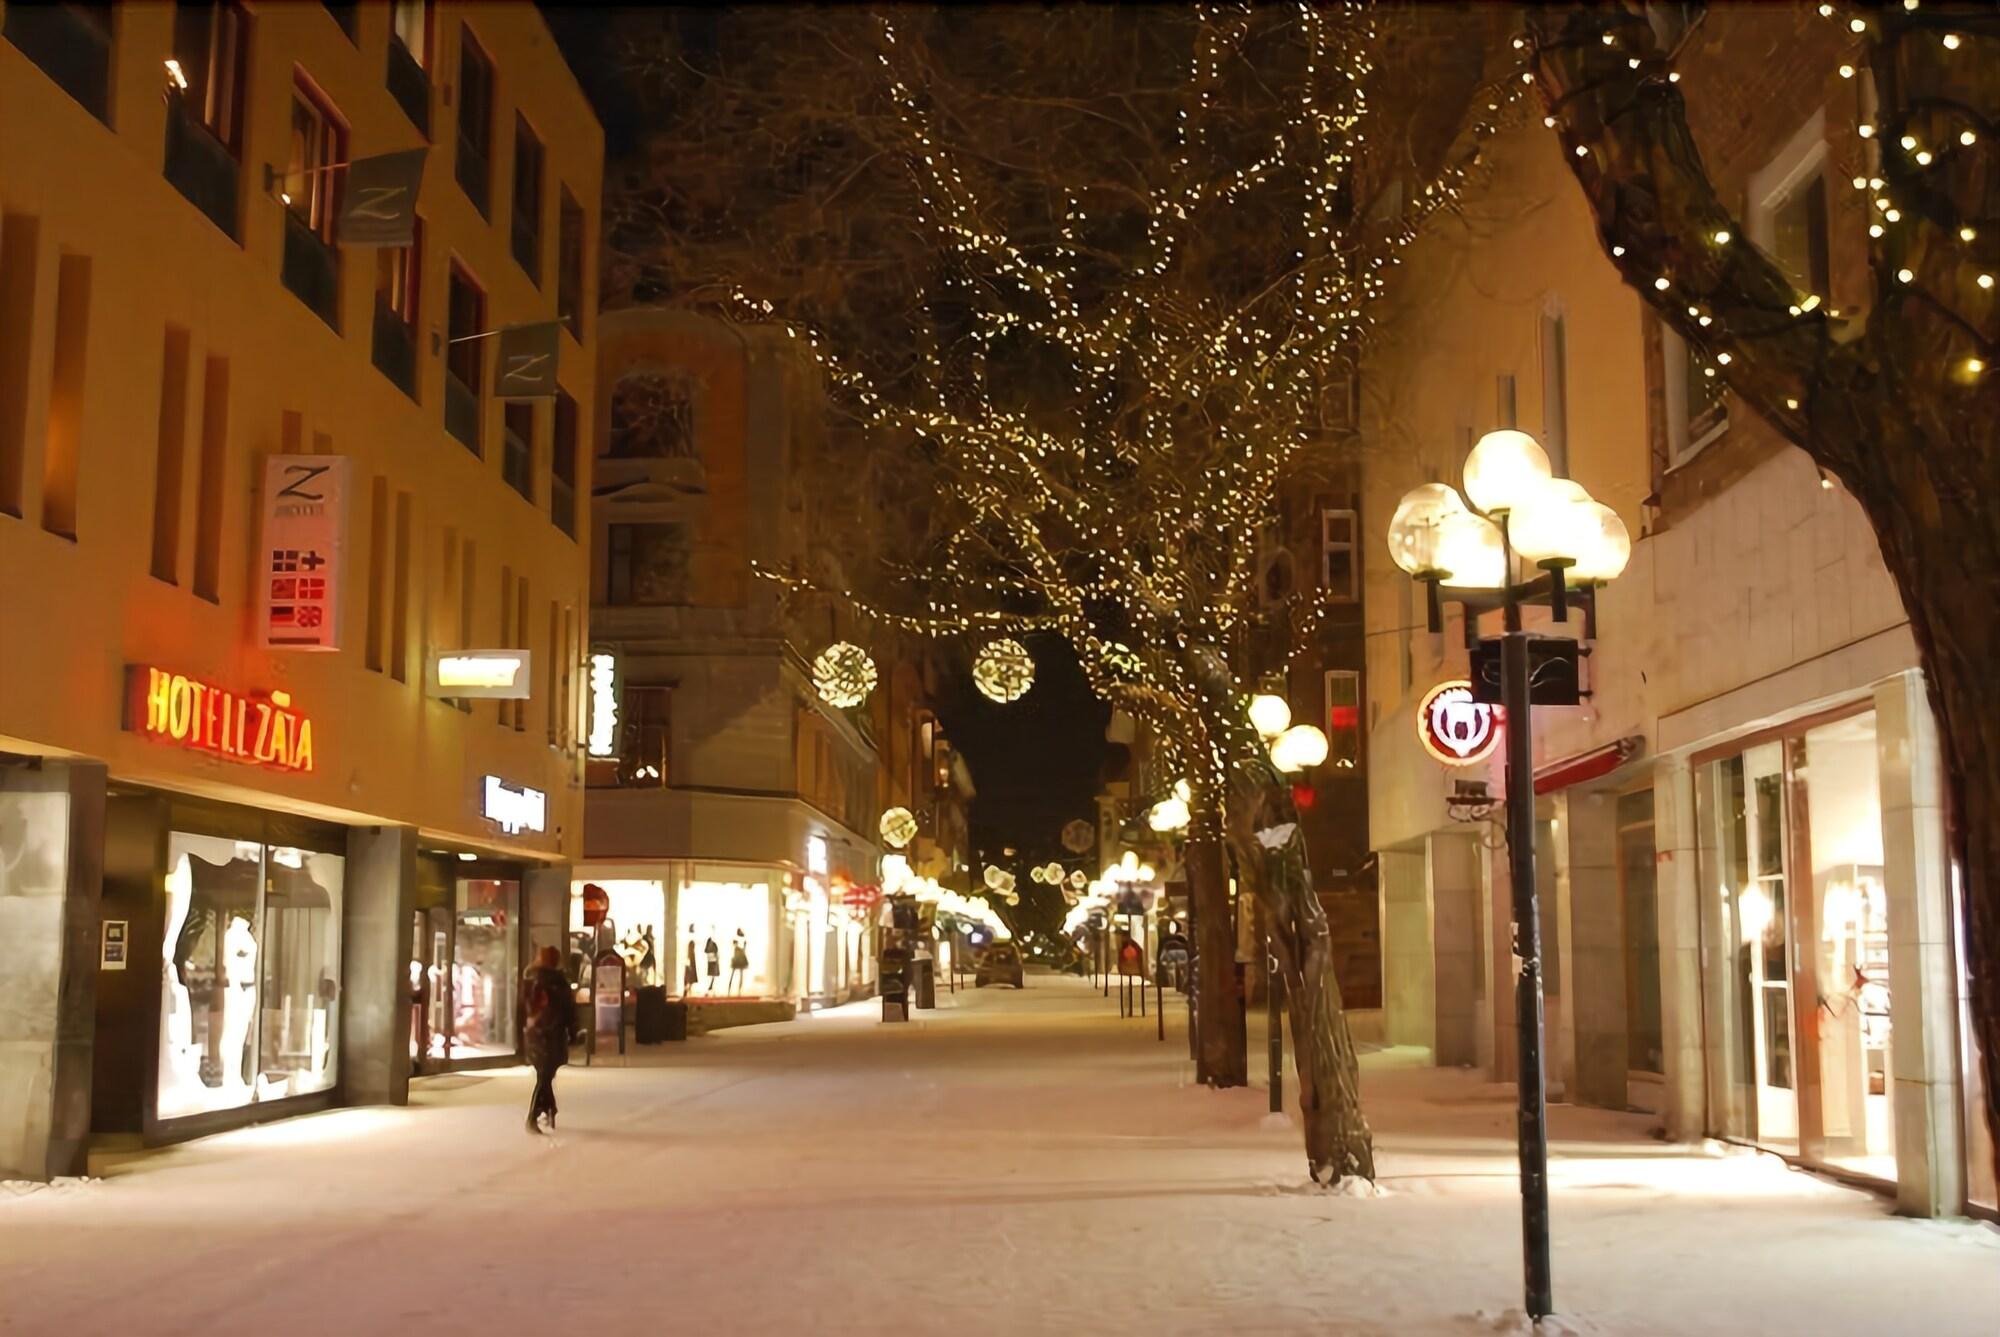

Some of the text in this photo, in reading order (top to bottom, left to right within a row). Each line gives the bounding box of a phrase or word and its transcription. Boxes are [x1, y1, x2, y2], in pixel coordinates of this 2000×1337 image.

[350, 186, 408, 220] Z
[277, 464, 331, 501] Z
[147, 667, 249, 757] HOTELL
